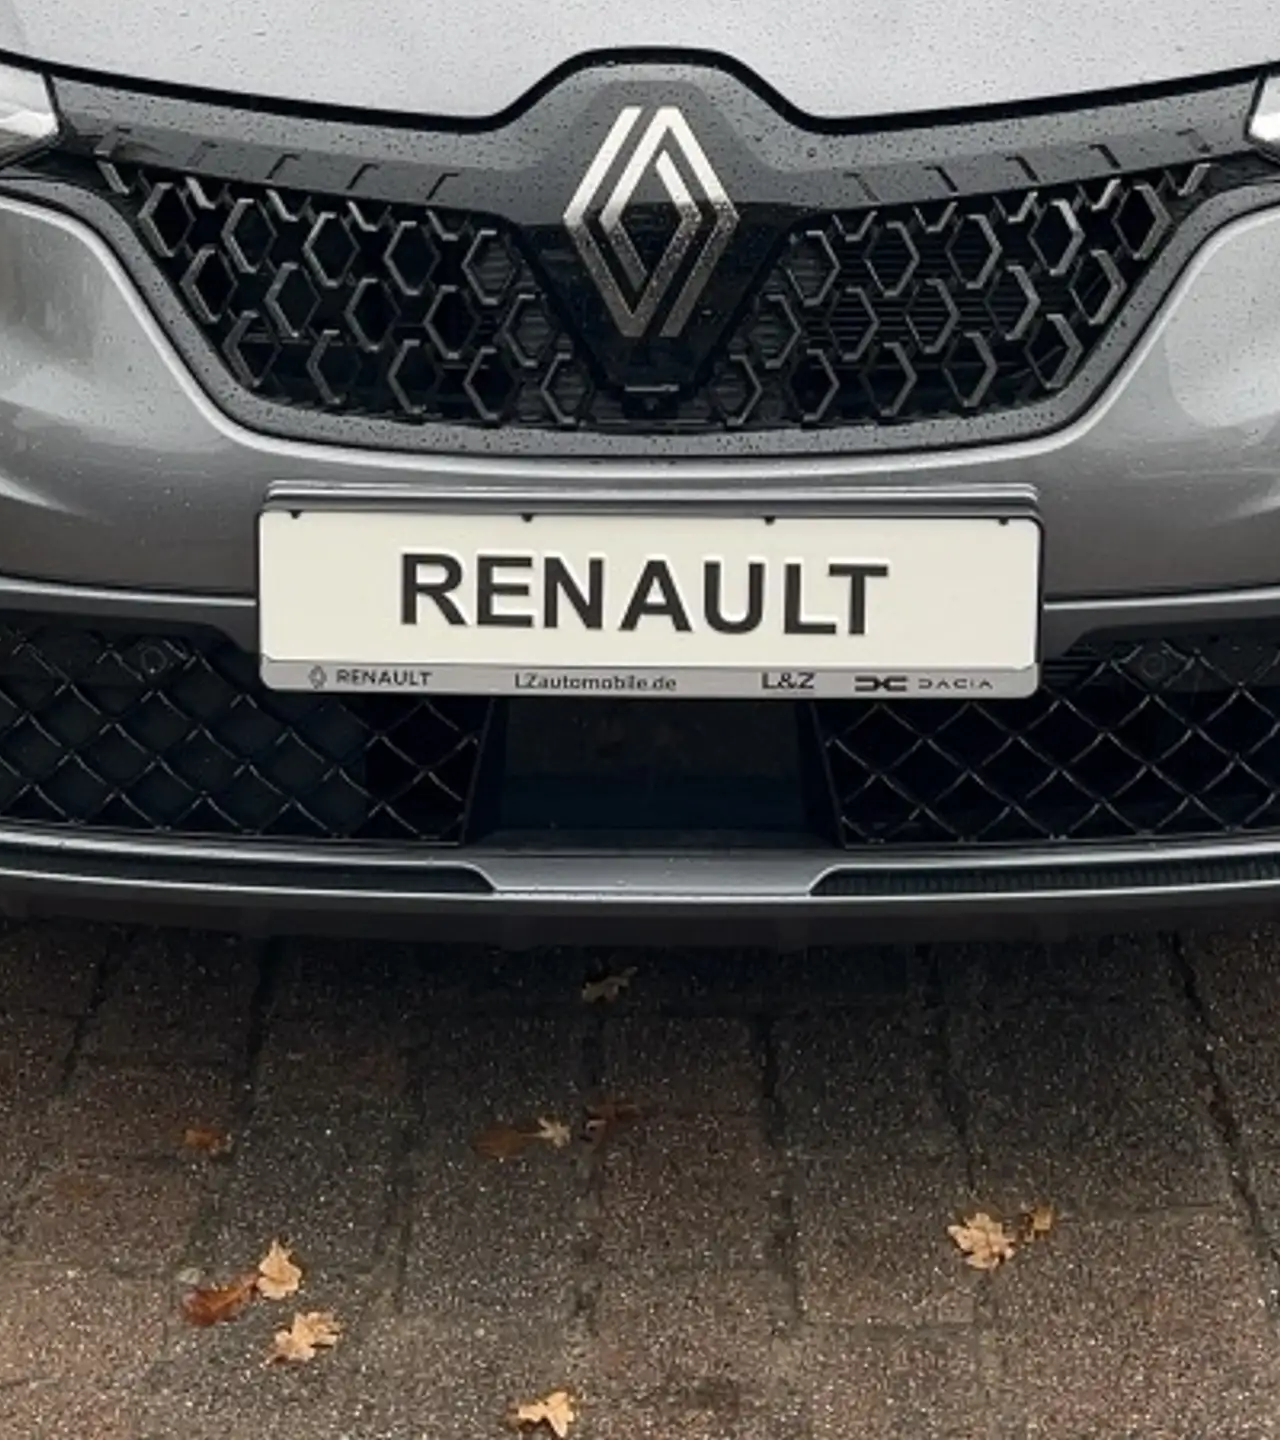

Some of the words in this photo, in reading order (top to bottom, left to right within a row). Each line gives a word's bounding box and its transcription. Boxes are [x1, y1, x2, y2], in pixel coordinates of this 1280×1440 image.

[401, 553, 889, 636] RENAULT
[336, 668, 433, 686] RENAULT
[514, 673, 677, 691] LZautomobile.de
[761, 671, 816, 690] L&Z
[918, 677, 994, 690] DACIA
